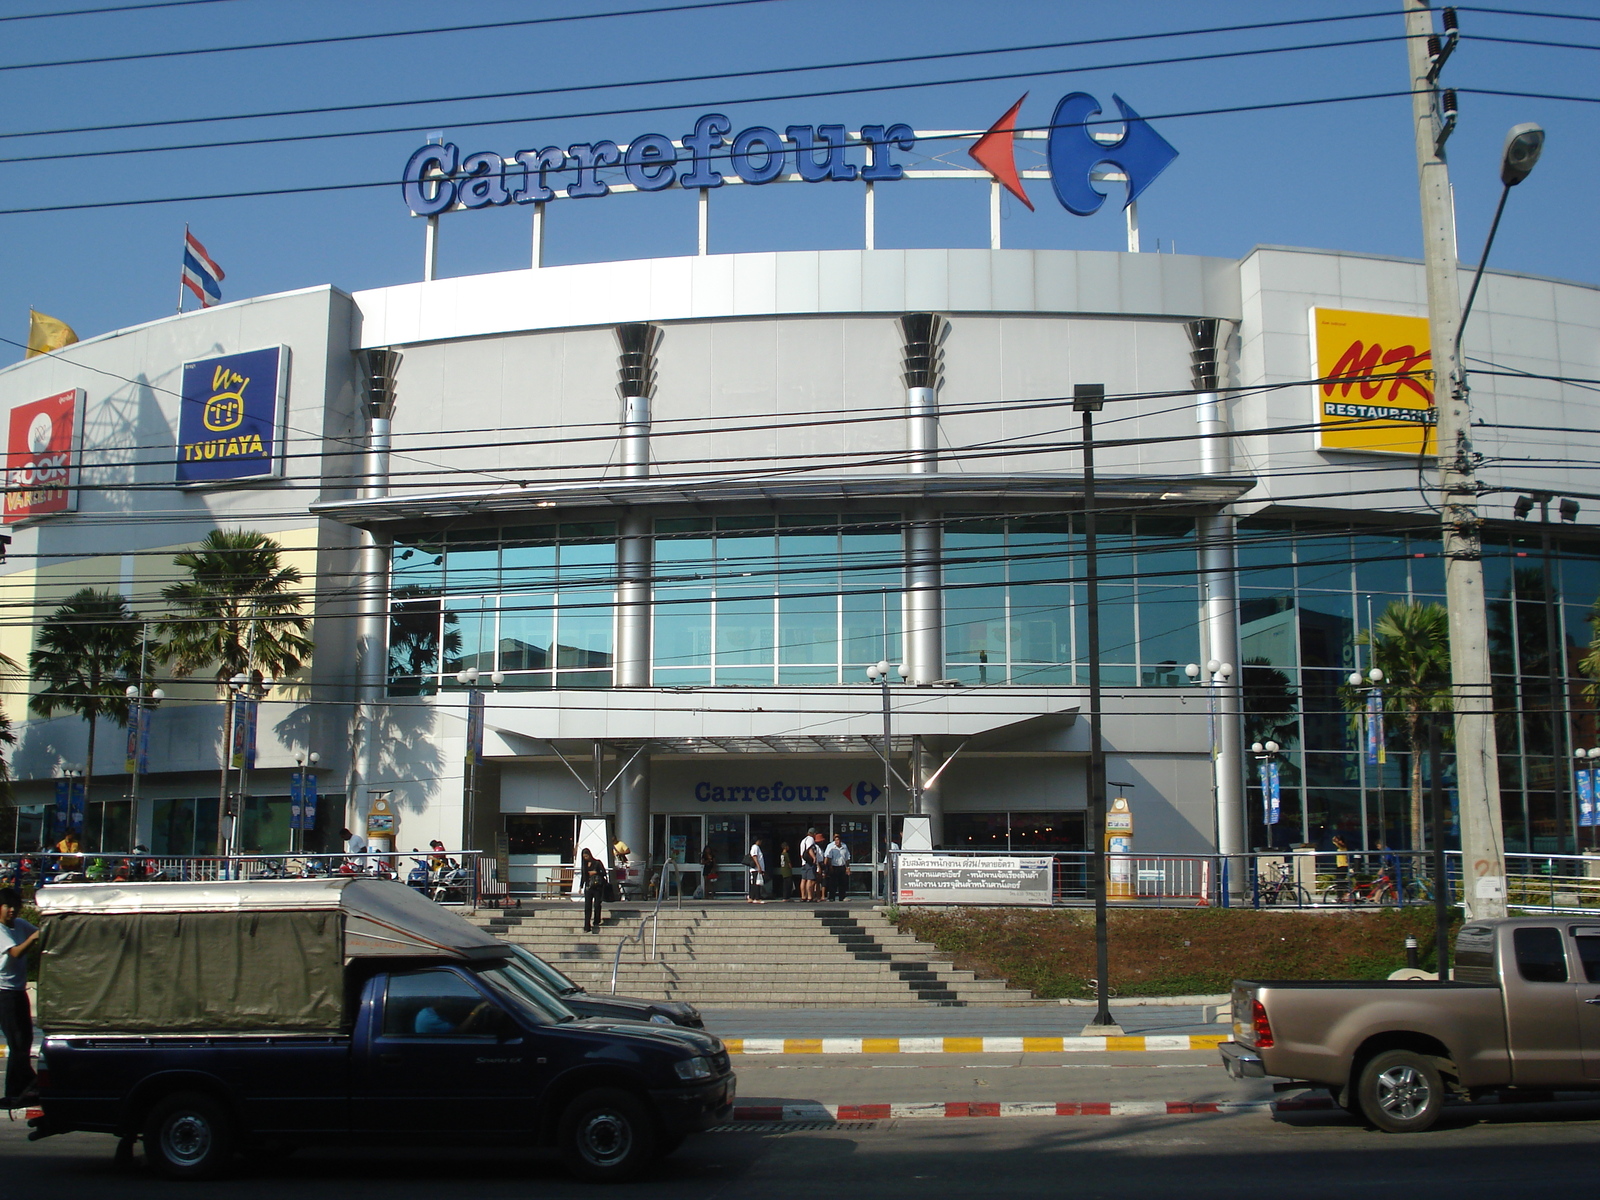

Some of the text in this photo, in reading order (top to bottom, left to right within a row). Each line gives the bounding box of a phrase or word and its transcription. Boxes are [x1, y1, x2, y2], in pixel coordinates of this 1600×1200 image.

[402, 112, 915, 216] Carrefour
[1323, 339, 1435, 405] MK
[184, 433, 263, 461] TSUTAYA
[8, 453, 67, 488] BOOK
[7, 477, 67, 511] VARIETY
[694, 781, 829, 802] Carrefour
